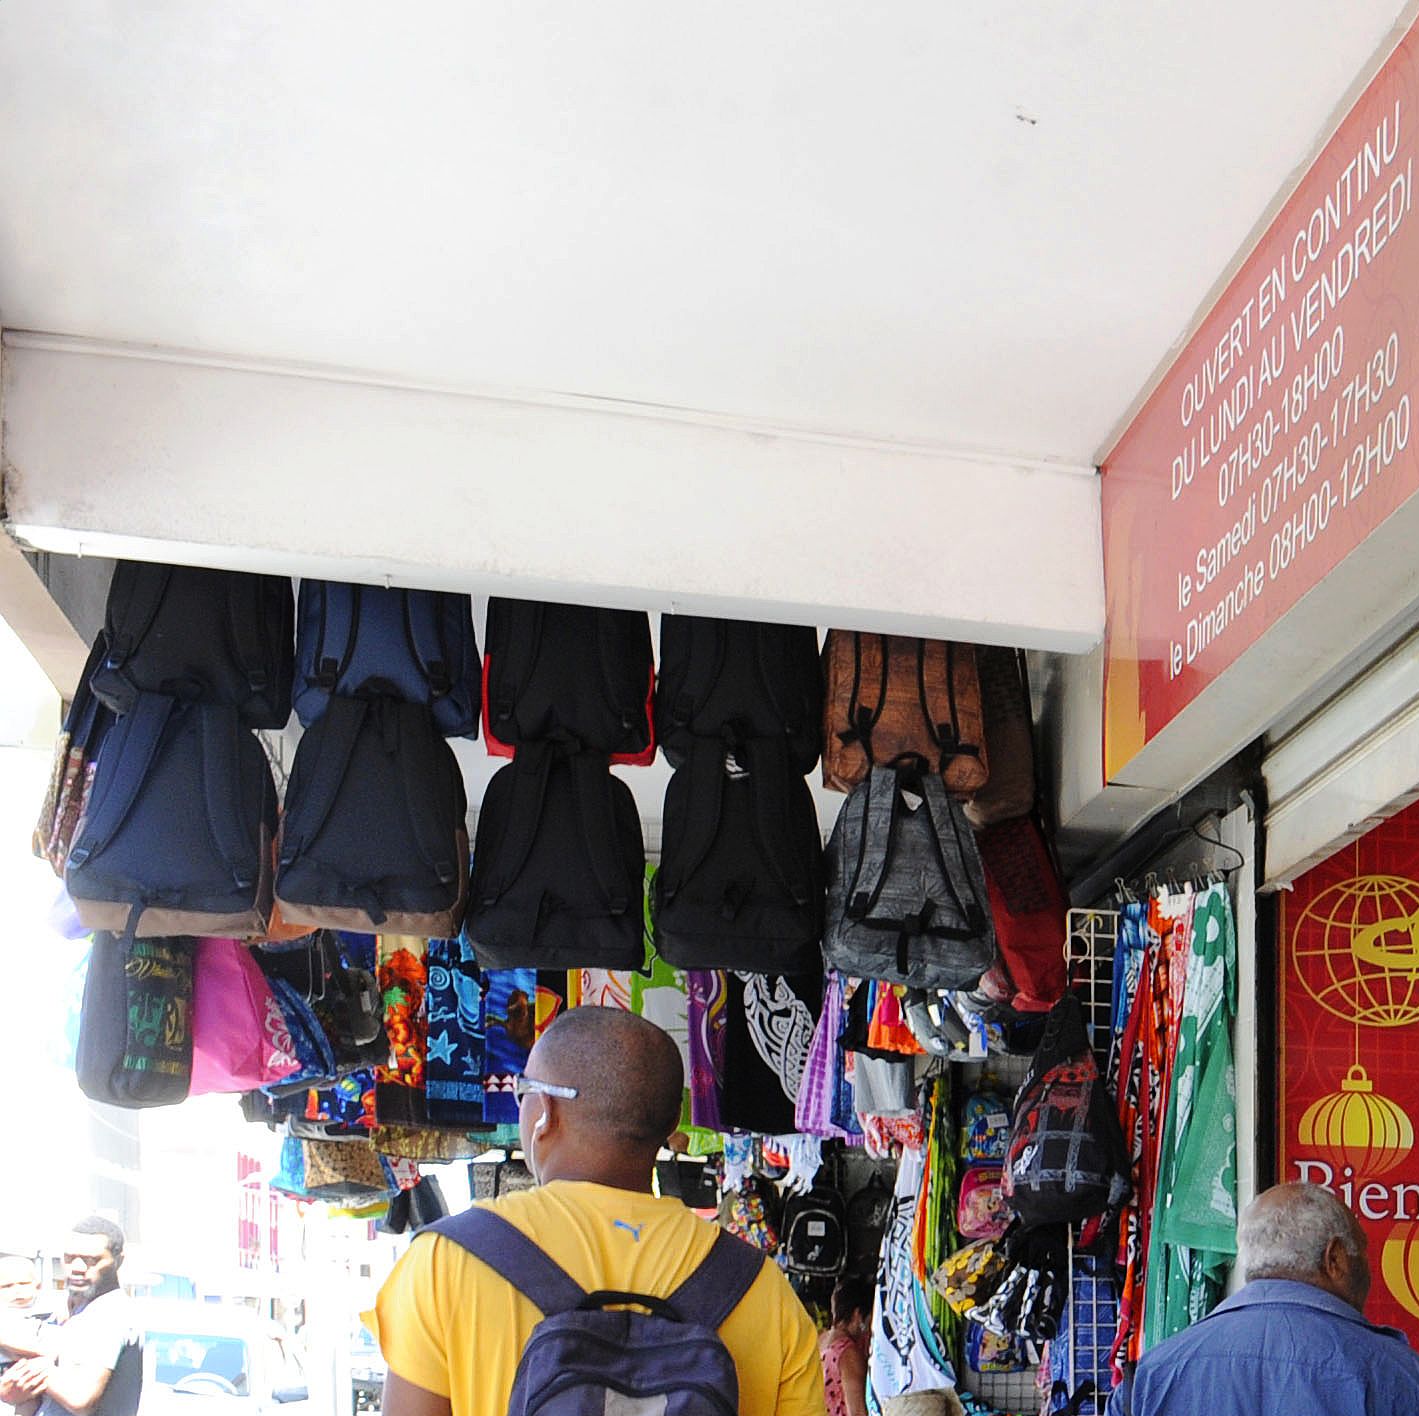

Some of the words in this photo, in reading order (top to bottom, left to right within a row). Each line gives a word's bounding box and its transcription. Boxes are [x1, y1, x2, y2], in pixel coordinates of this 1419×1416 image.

[1171, 438, 1196, 500] DU
[1200, 366, 1253, 468] LUNDI
[1258, 325, 1284, 399] AU
[1291, 158, 1412, 351] VENDREDI
[1181, 298, 1254, 427] OUVERT
[1259, 254, 1285, 330] EN
[1292, 100, 1400, 282] CONTINU
[1170, 641, 1182, 681] le
[1186, 561, 1264, 665] Dimanche
[1178, 572, 1192, 611] le
[1196, 493, 1256, 593] Samedi
